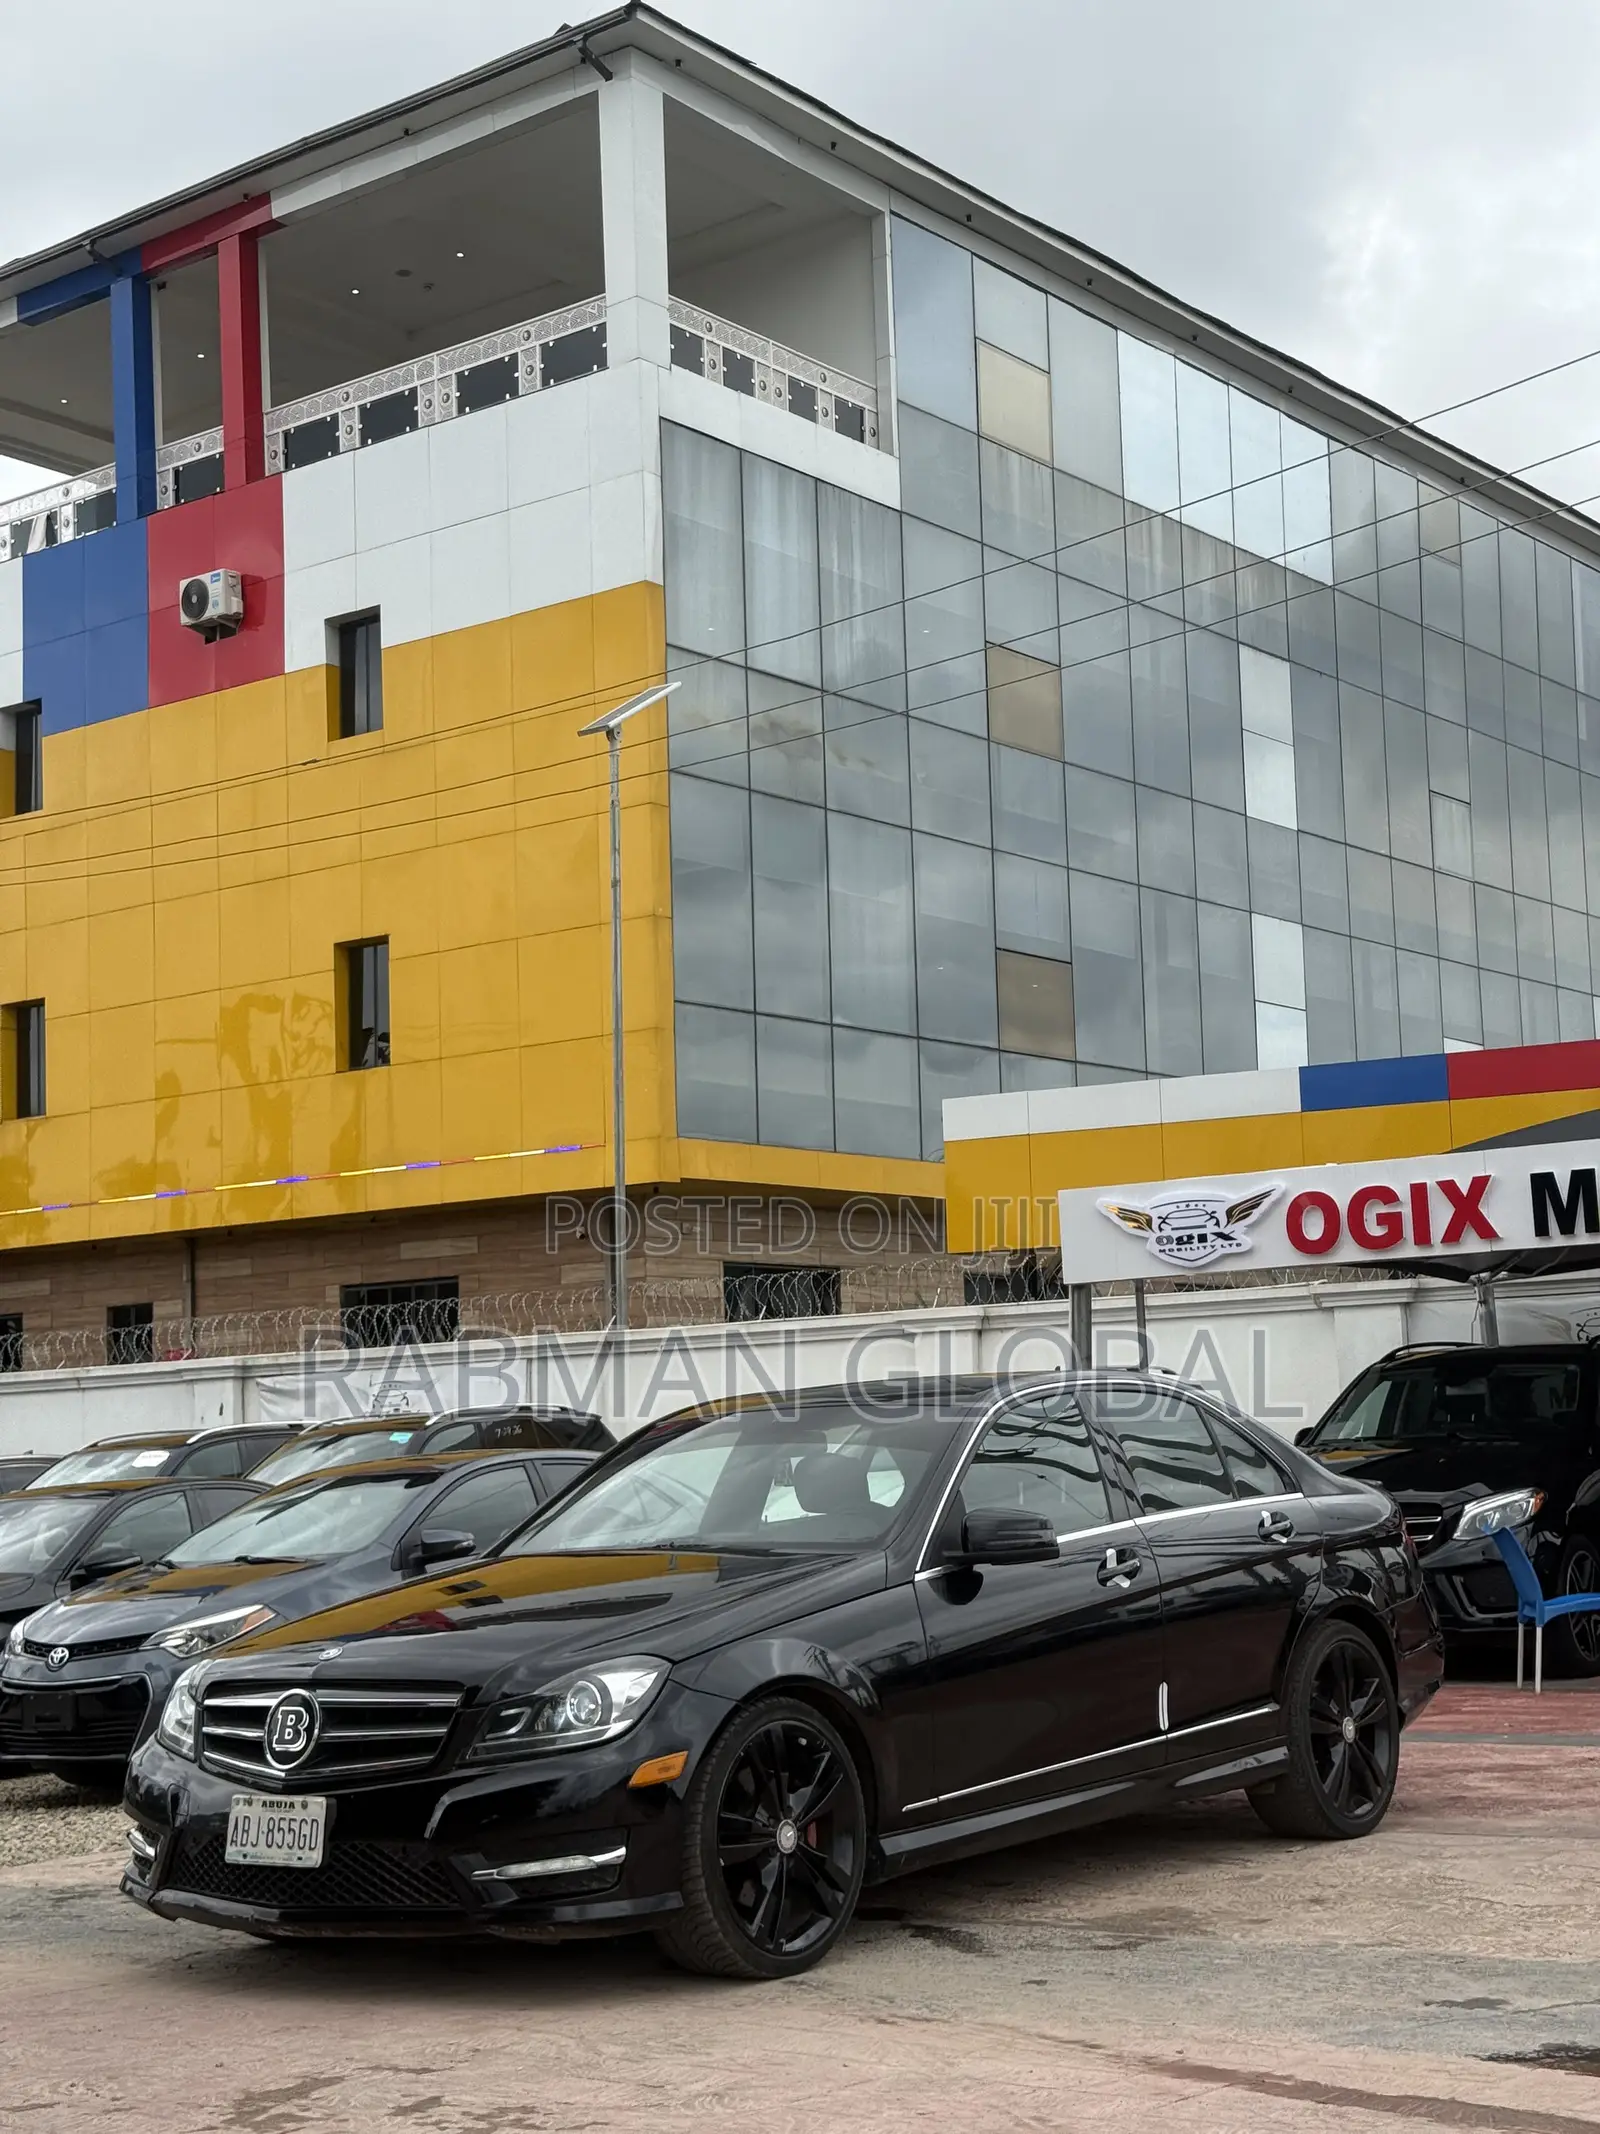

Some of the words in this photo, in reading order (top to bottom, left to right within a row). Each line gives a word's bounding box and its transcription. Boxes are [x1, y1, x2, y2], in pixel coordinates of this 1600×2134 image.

[1286, 1174, 1497, 1255] OGIX
[1158, 1244, 1216, 1253] MOBILITY
[272, 1706, 309, 1752] B
[261, 1800, 296, 1810] ABUJA
